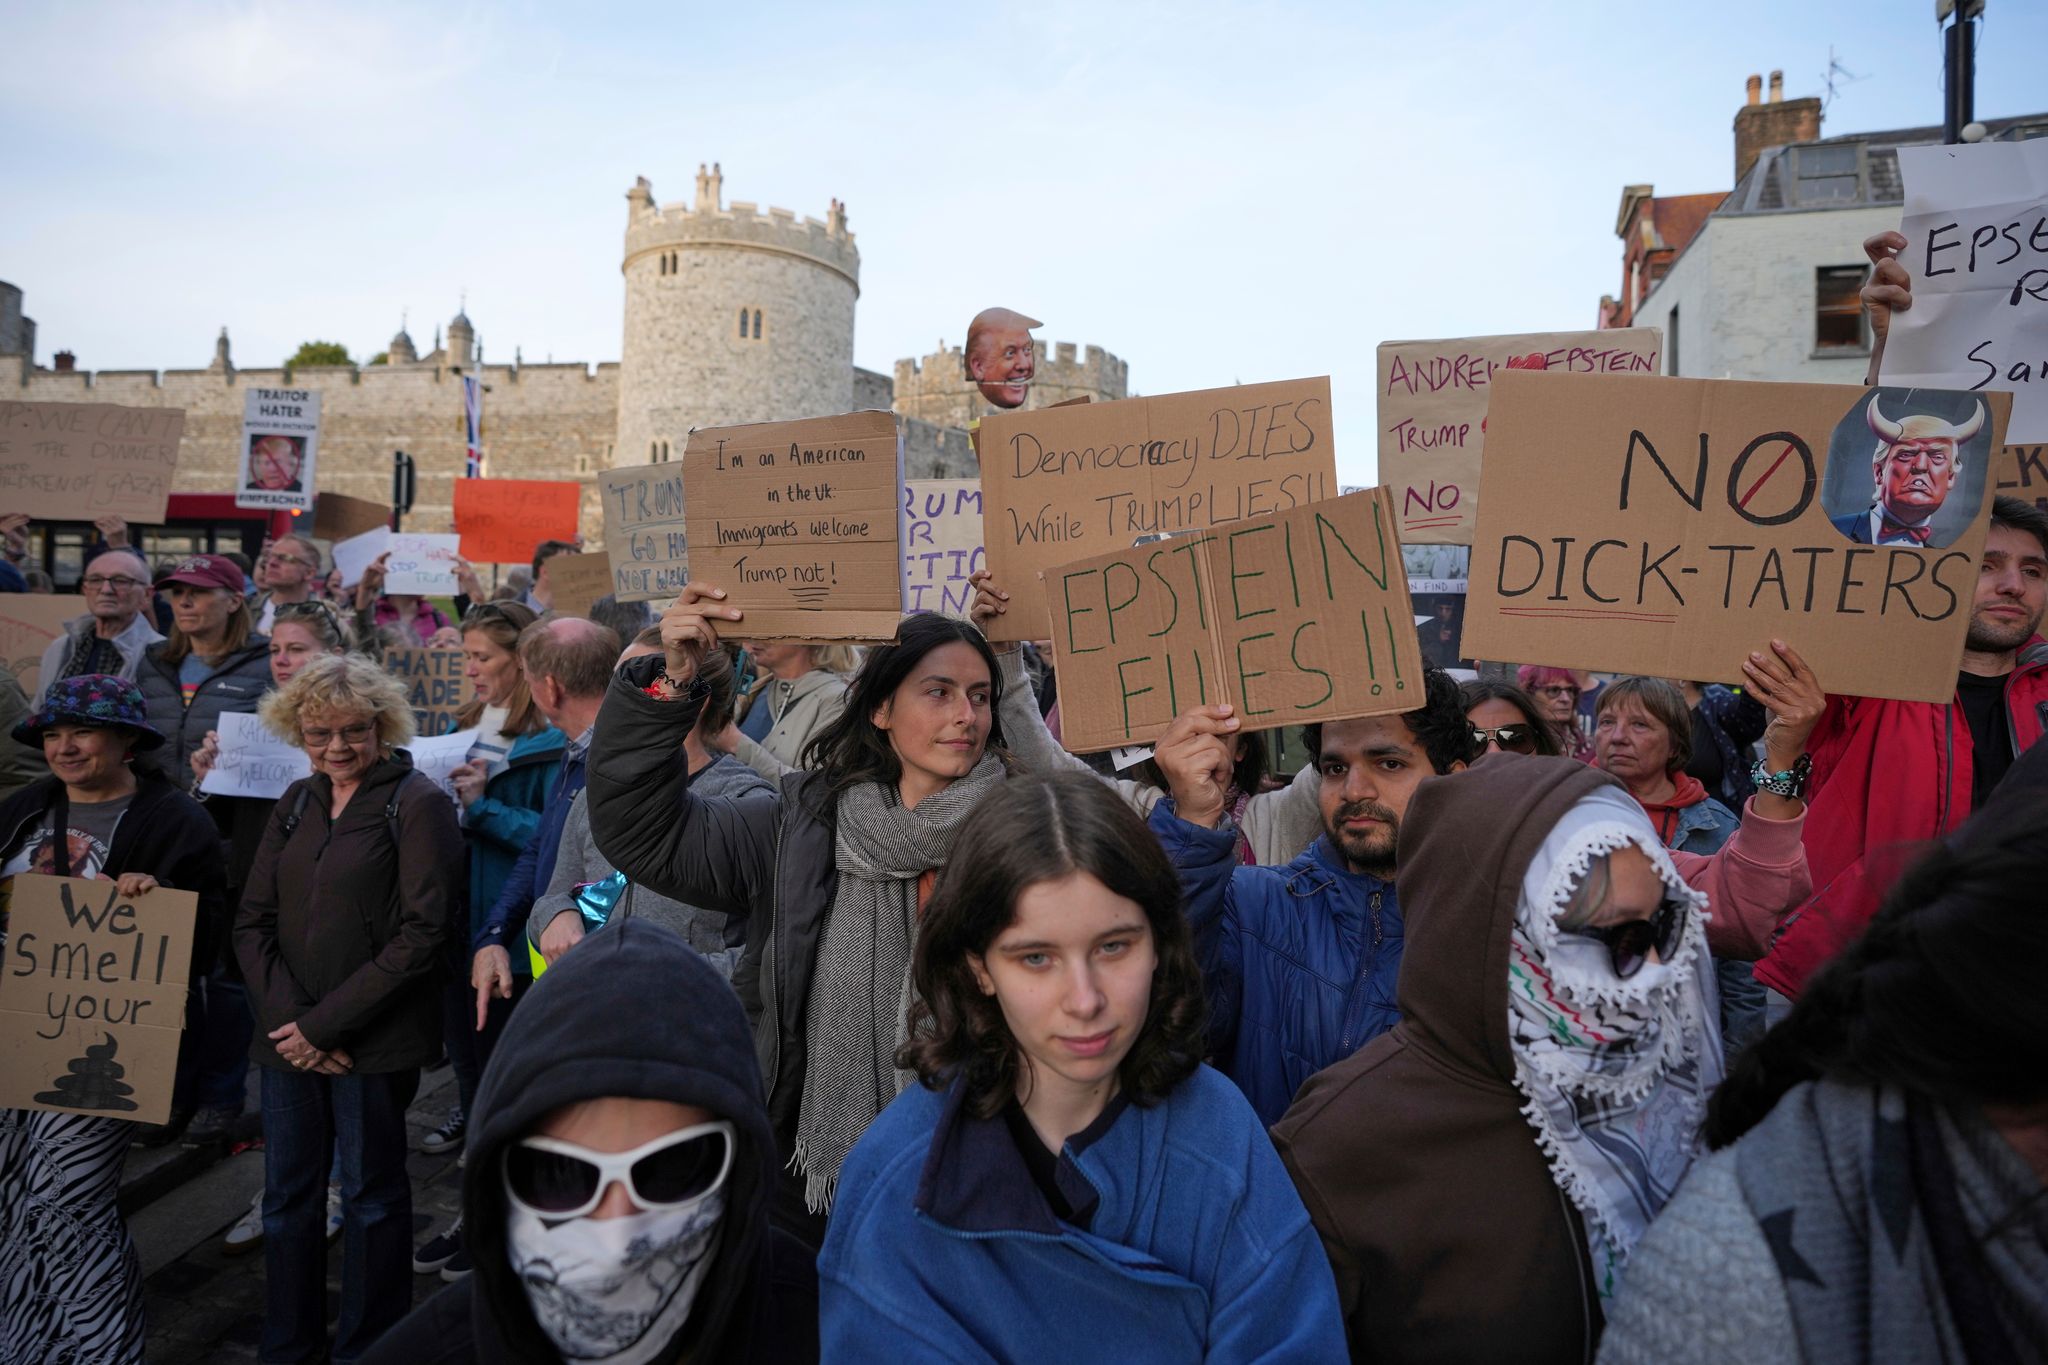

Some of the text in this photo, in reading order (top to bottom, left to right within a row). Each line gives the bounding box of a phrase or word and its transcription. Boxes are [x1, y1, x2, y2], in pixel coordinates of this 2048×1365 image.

[257, 389, 309, 402] TRAITOR
[36, 408, 88, 433] WE
[260, 404, 303, 418] HATER
[32, 440, 71, 458] THE
[91, 441, 176, 467] DINNER
[716, 438, 866, 470] I'm an American
[1010, 399, 1320, 489] Democracy DIES
[1618, 430, 1818, 526] NO
[767, 488, 780, 503] in
[787, 483, 811, 502] the
[1404, 480, 1460, 516] NO
[1007, 504, 1084, 546] While
[1096, 492, 1202, 537] TRUMP
[394, 538, 428, 553] STOP
[631, 533, 657, 560] GO
[717, 520, 798, 550] Immigrants
[391, 561, 417, 573] STOP
[426, 547, 454, 561] HAT
[616, 569, 651, 591] NOT
[733, 556, 787, 584] Trump
[1064, 501, 1388, 653] EPSTEIN
[1497, 535, 1971, 622] DICK-TATERS
[1424, 582, 1449, 592] FIND
[1456, 583, 1465, 593] IT
[387, 650, 463, 676] HATE
[410, 679, 461, 706] ADE
[60, 882, 137, 935] We
[36, 992, 152, 1039] your
